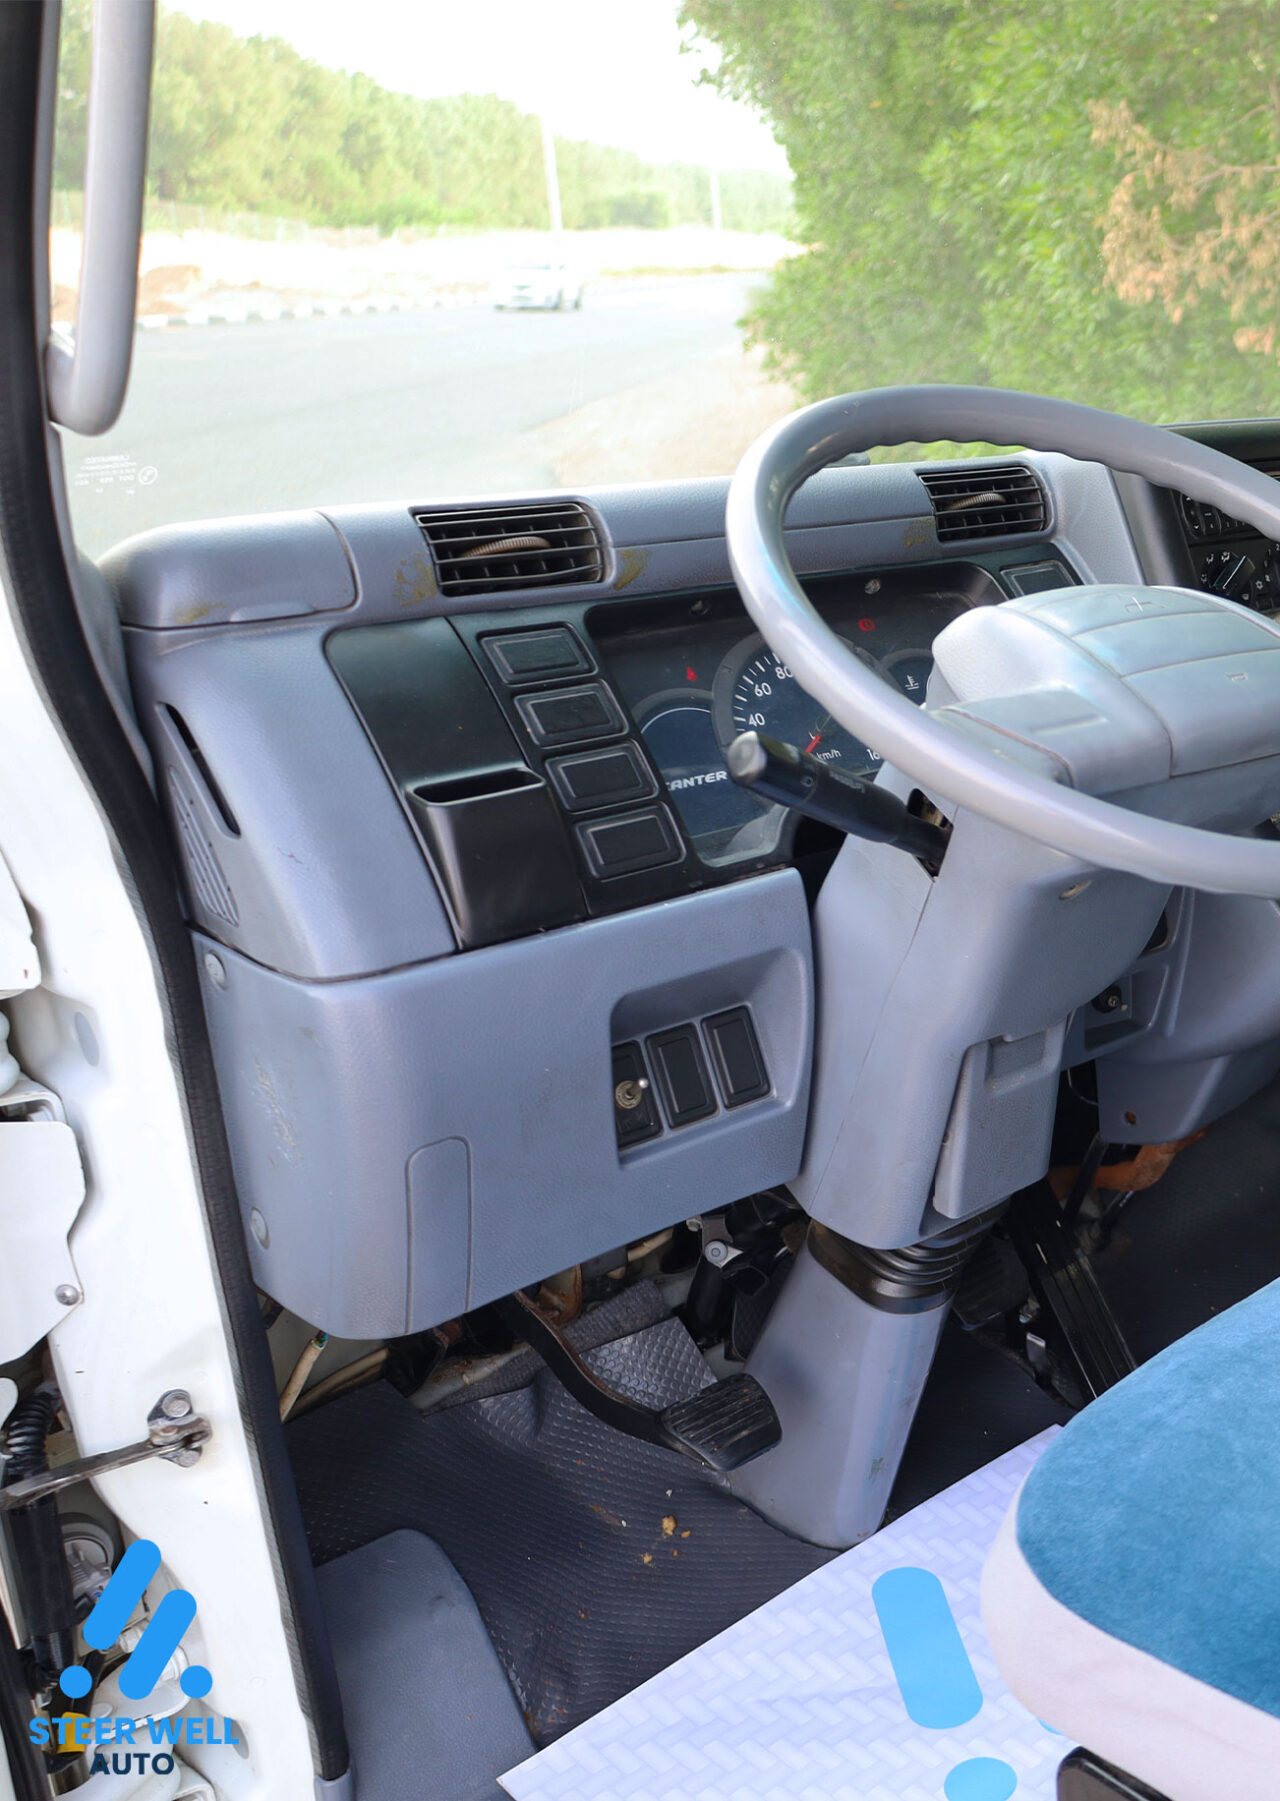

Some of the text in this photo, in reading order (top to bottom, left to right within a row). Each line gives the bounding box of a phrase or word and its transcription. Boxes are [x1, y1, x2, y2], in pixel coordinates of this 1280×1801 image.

[775, 666, 793, 679] 80
[754, 682, 772, 697] 60
[748, 713, 765, 727] 40
[815, 749, 842, 761] km/h
[866, 748, 881, 761] 16
